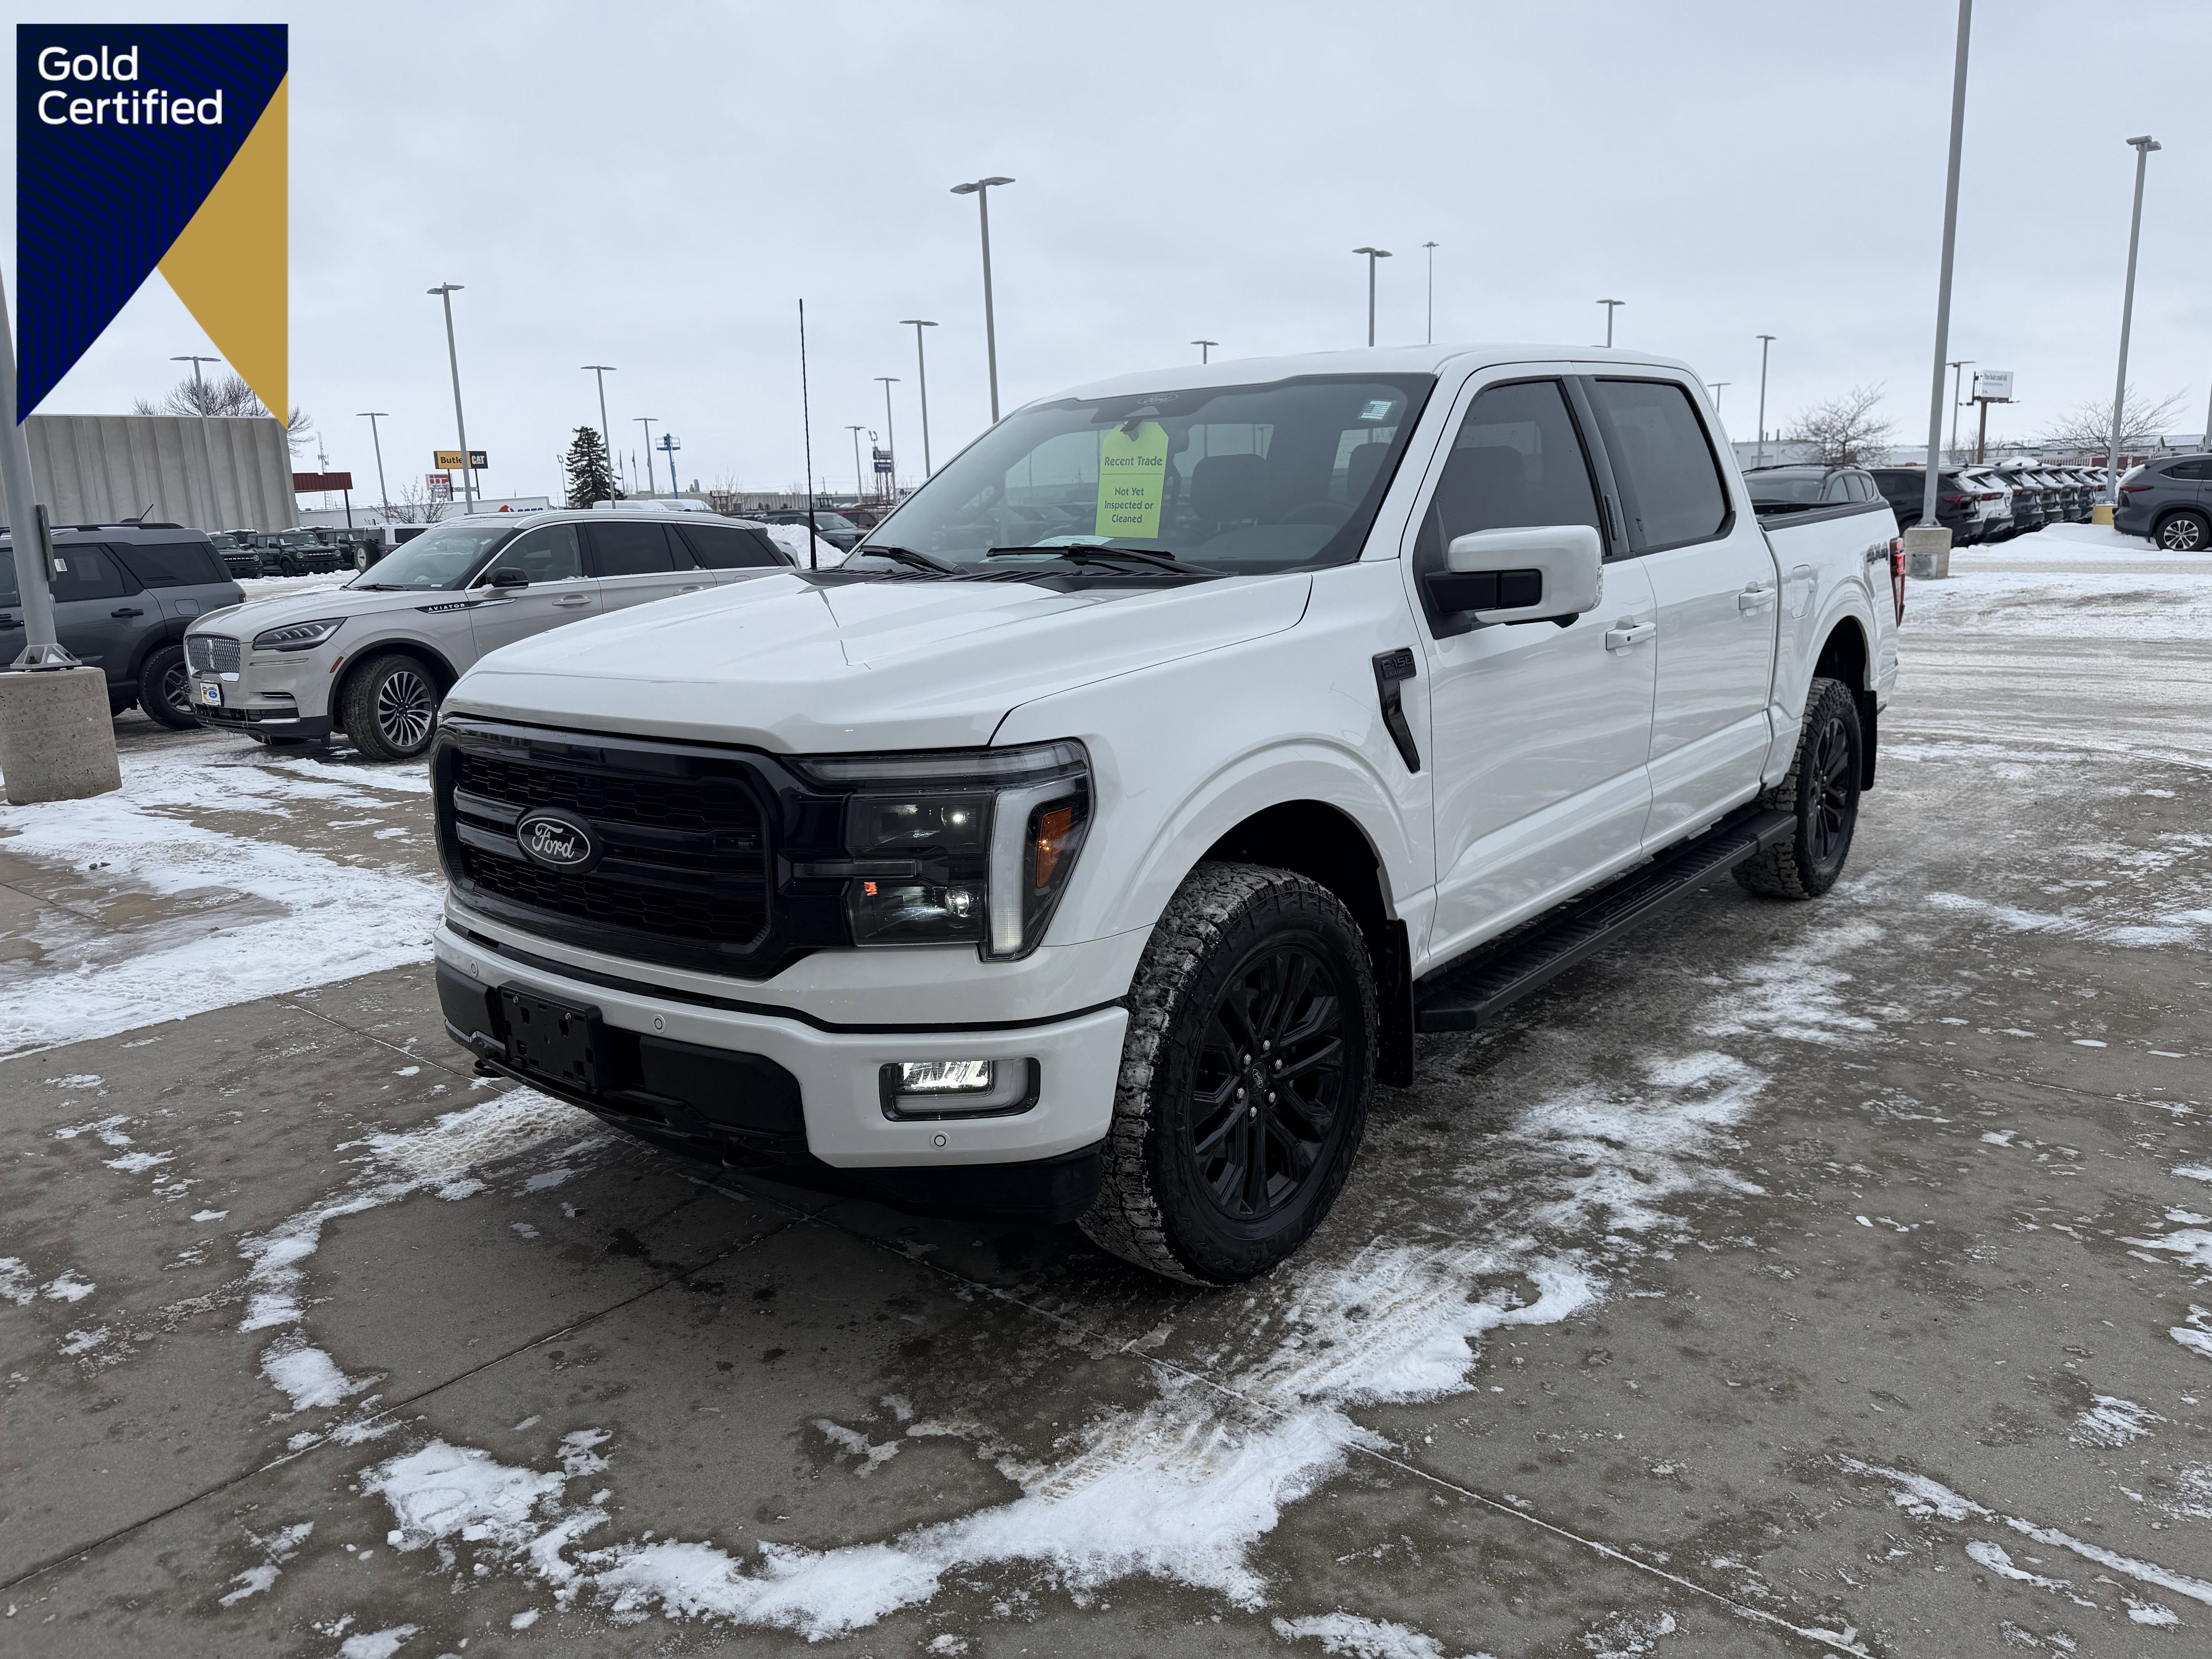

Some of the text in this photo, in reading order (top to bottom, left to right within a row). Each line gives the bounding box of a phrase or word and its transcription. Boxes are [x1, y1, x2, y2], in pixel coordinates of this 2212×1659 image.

[472, 455, 485, 465] CAT
[1104, 456, 1163, 466] Recent Trade
[1115, 487, 1144, 496] Not Yet
[1104, 501, 1142, 510] Inspected
[1111, 514, 1142, 523] Cleaned
[428, 603, 465, 611] AVIATOR
[1381, 654, 1413, 671] F-150
[1385, 668, 1405, 678] LARIAT
[532, 823, 575, 859] Ford
[1254, 1072, 1262, 1085] Ford
